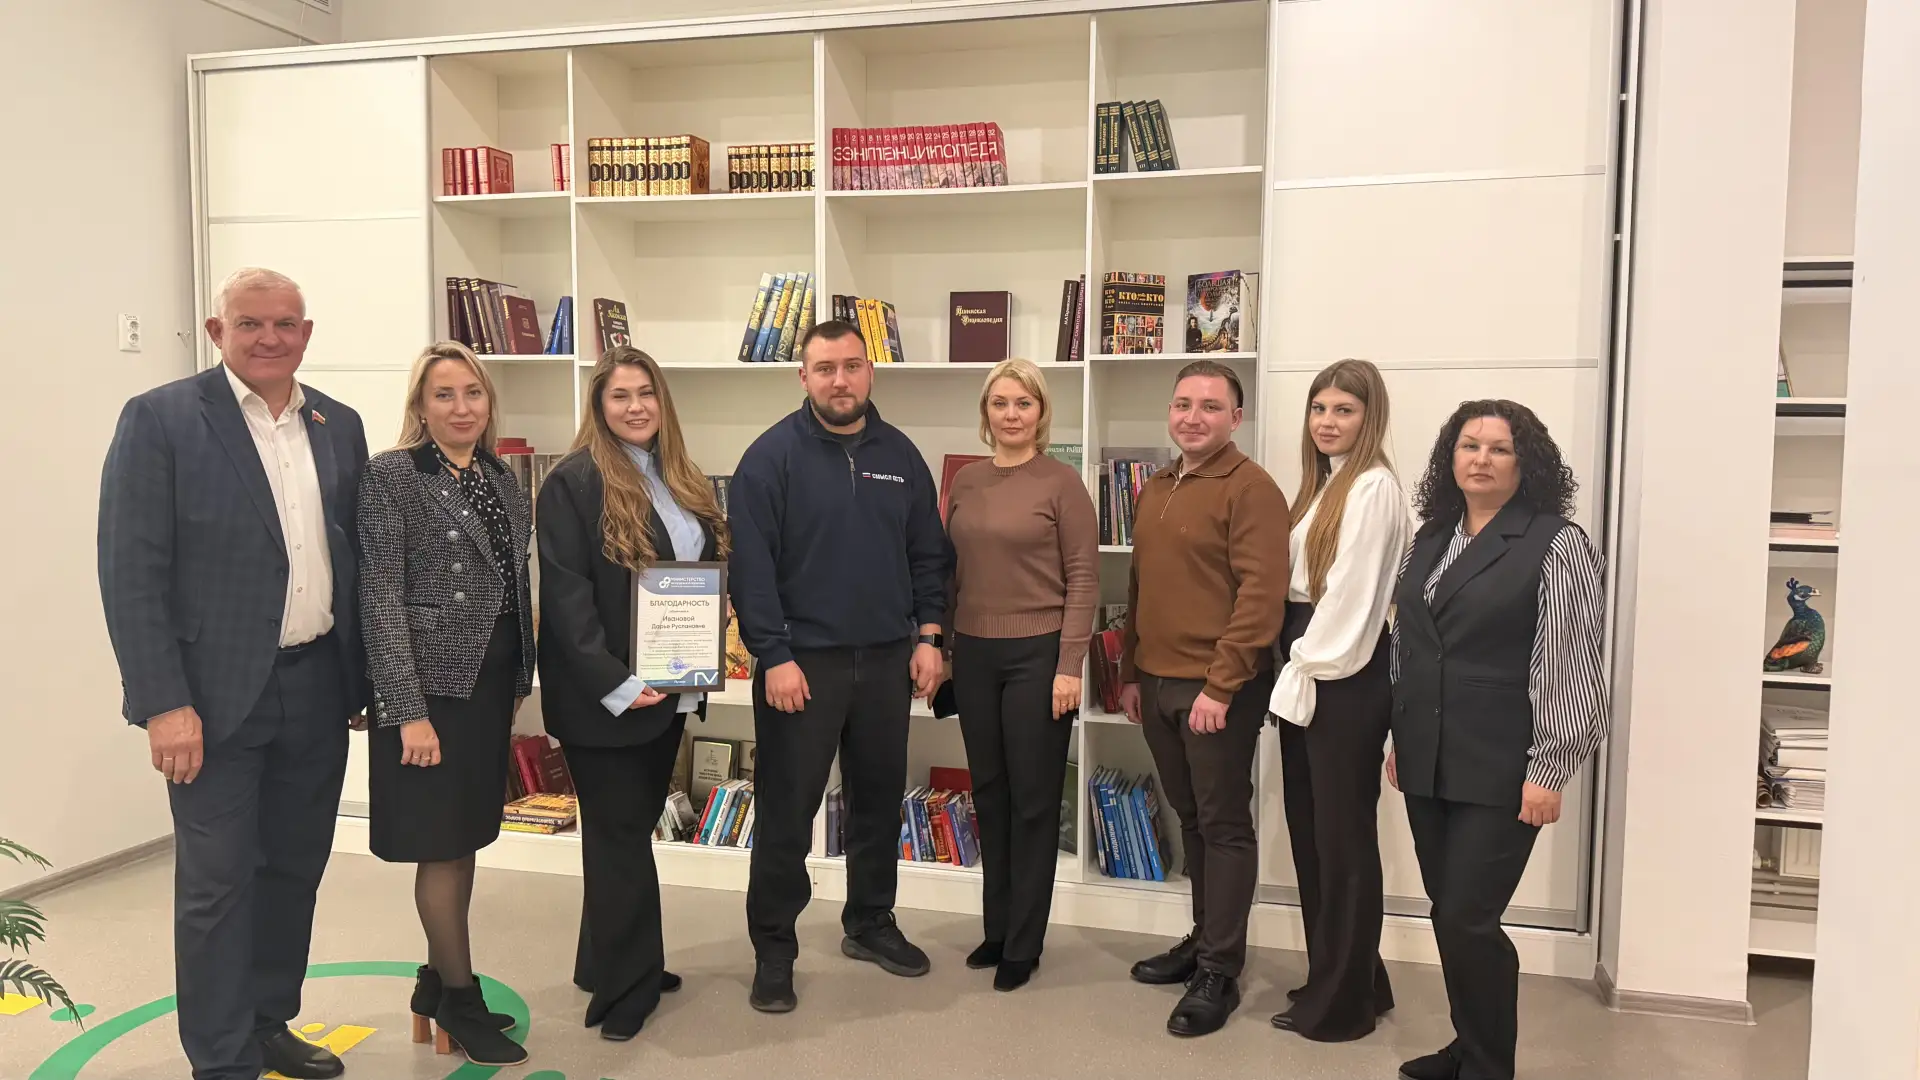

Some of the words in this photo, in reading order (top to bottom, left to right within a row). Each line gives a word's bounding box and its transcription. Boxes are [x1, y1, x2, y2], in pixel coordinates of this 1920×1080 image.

[933, 132, 941, 140] 24
[942, 131, 950, 139] 25
[988, 128, 995, 136] 32
[1119, 292, 1137, 301] КТО
[1146, 294, 1164, 302] КТО
[892, 475, 905, 483] ЕСТЬ
[649, 600, 710, 608] БЛАГОДАРНОСТЬ
